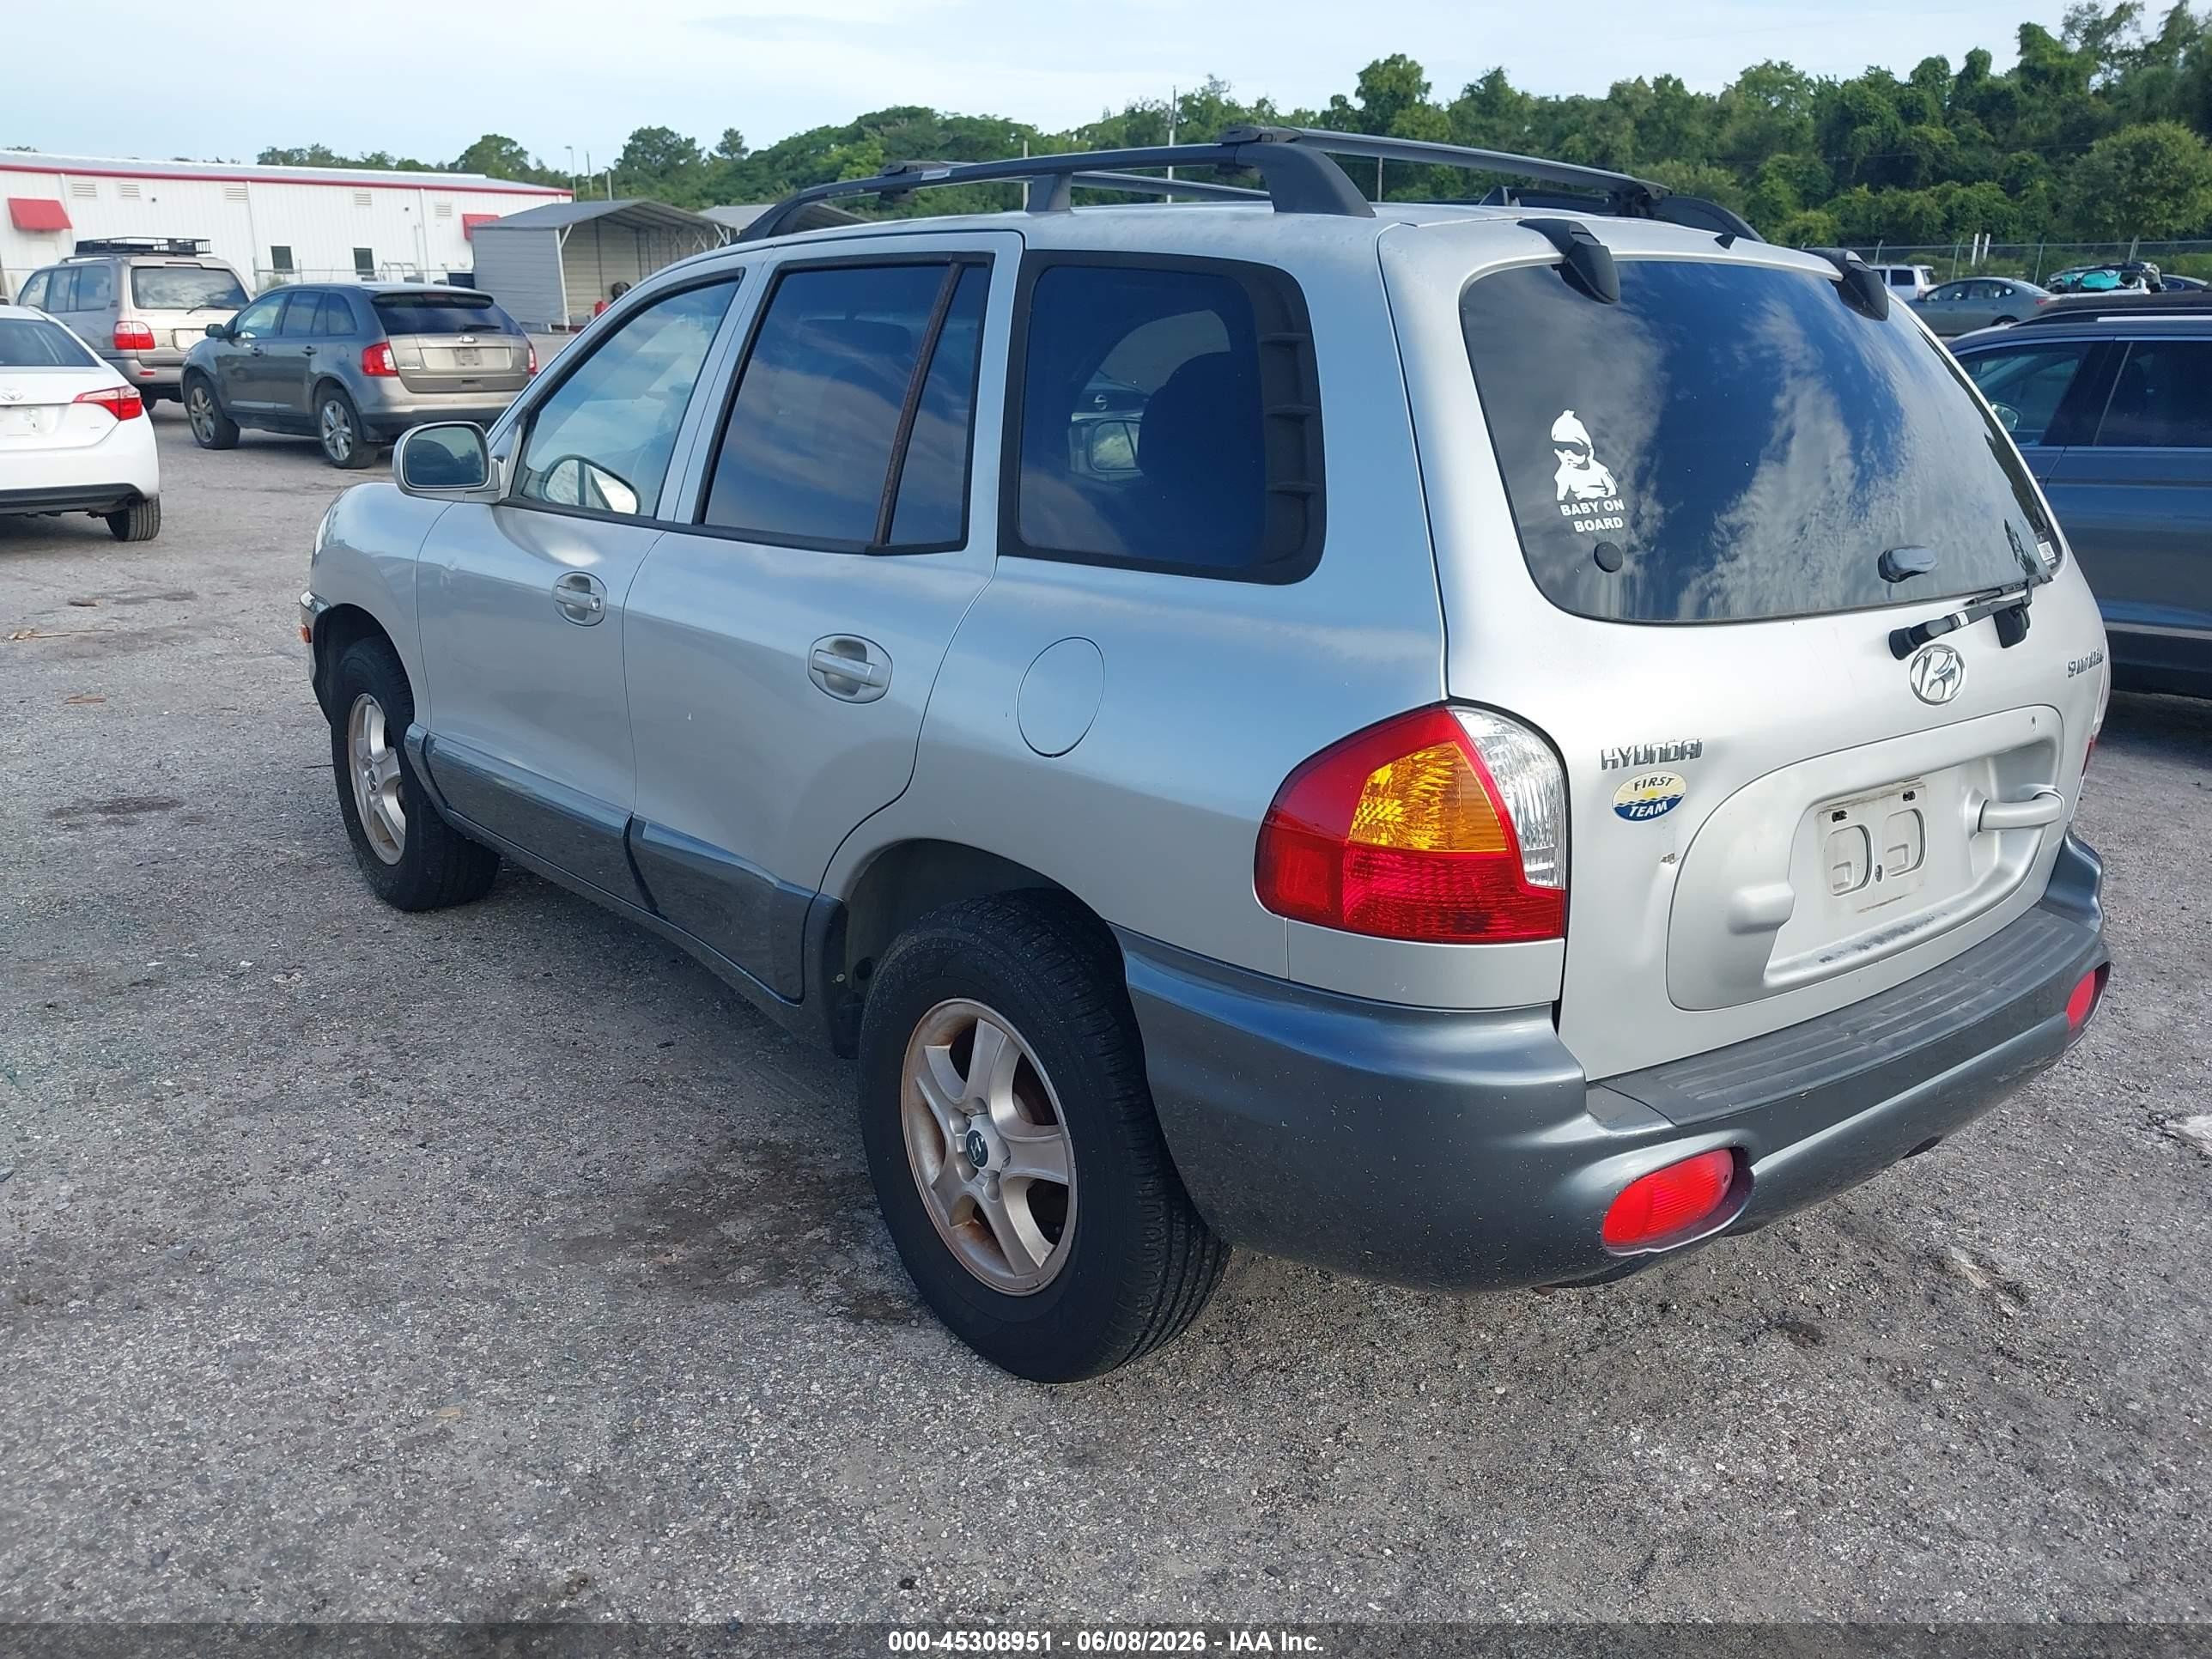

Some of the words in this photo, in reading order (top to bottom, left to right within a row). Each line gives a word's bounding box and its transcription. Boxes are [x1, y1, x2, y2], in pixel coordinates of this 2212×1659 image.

[1559, 501, 1599, 516] BABY
[1603, 499, 1625, 512] ON
[1573, 517, 1624, 532] BOARD
[1601, 738, 1703, 770] HYUNDAI
[1633, 776, 1674, 792] FIRST
[1628, 800, 1668, 817] TEAM
